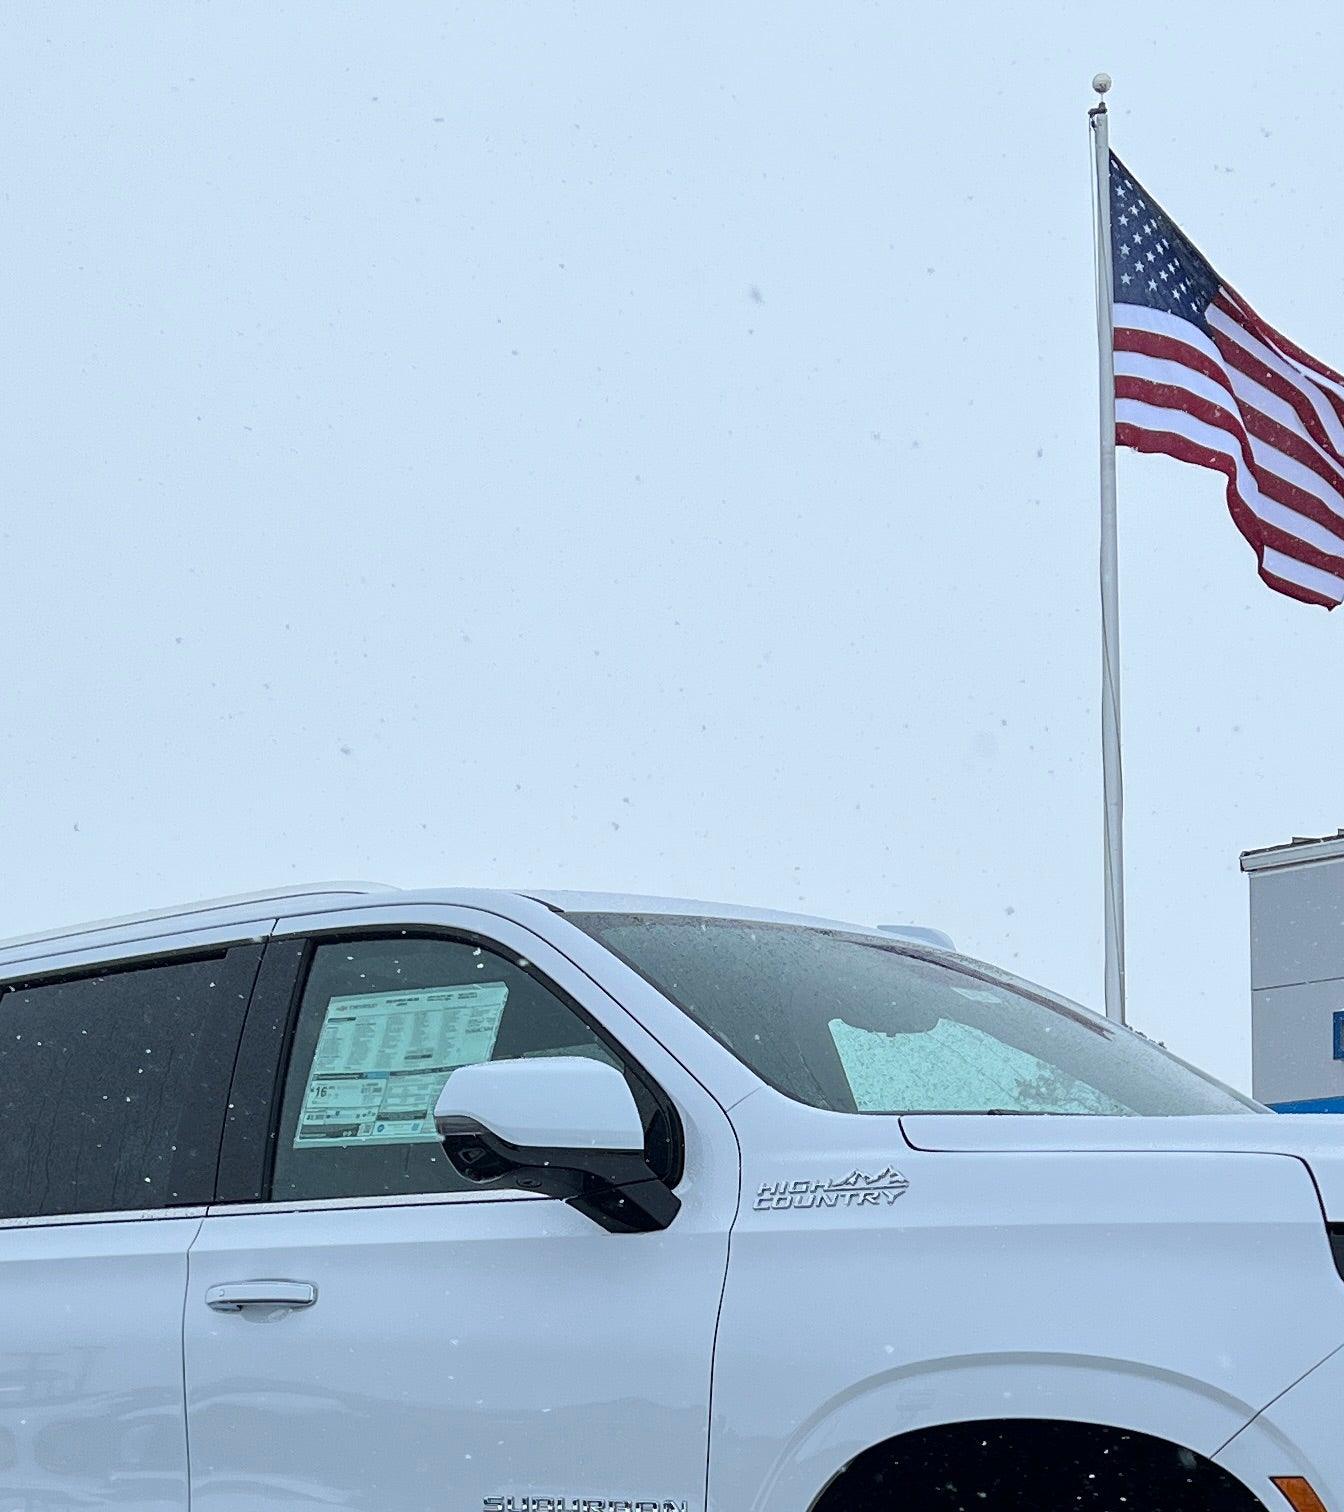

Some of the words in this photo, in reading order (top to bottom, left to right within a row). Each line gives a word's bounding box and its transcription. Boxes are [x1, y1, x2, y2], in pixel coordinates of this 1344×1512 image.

[315, 1086, 328, 1097] 16
[757, 1179, 833, 1197] HIGH
[752, 1190, 906, 1211] COUNTRY
